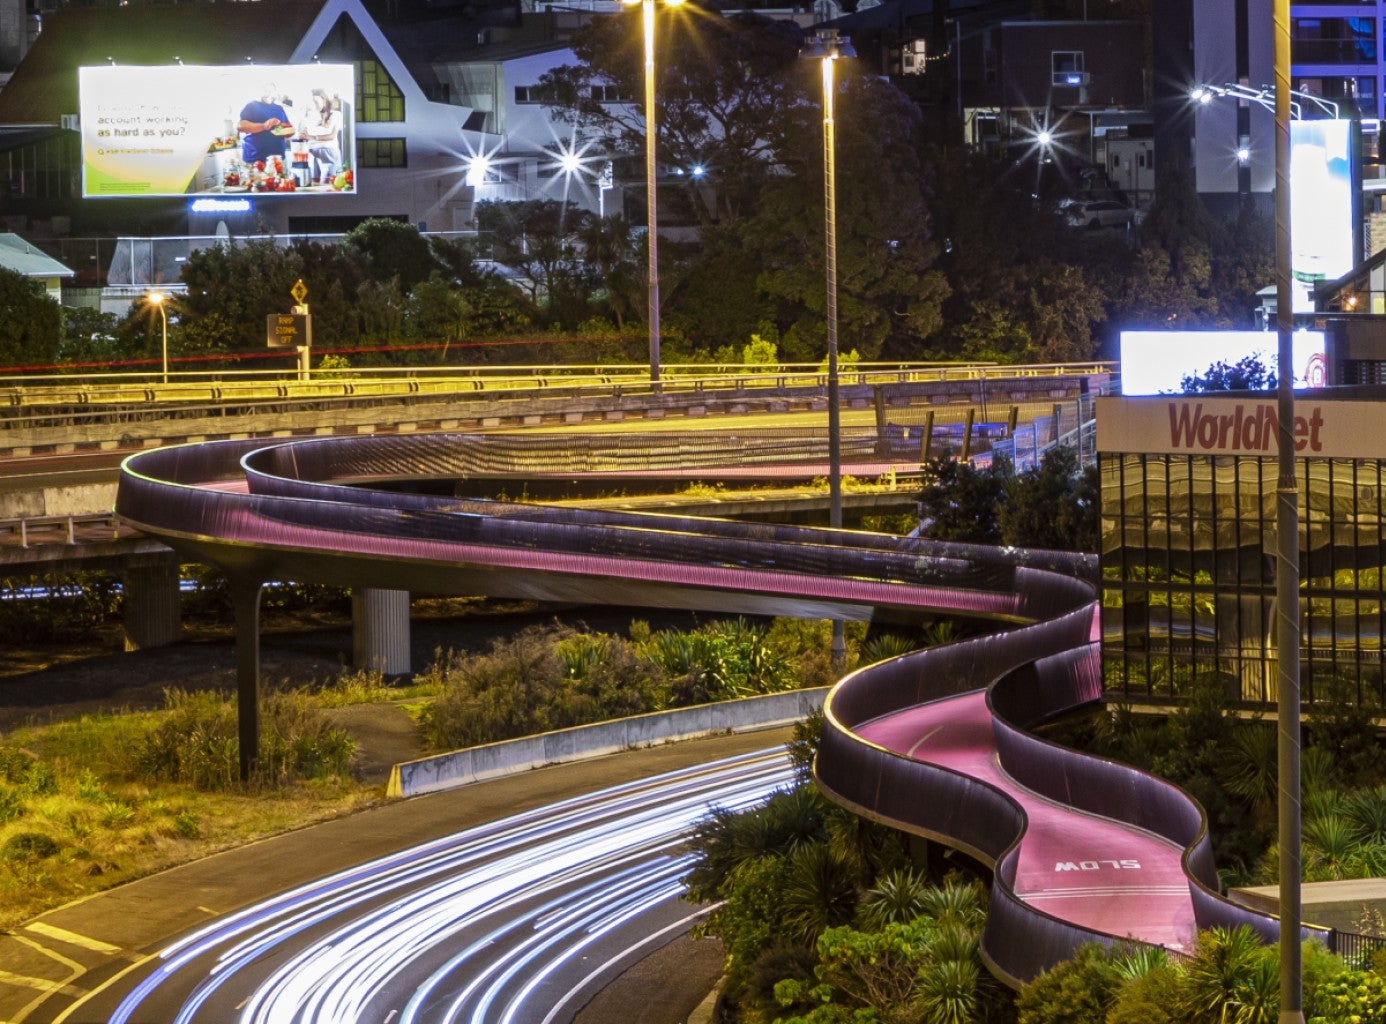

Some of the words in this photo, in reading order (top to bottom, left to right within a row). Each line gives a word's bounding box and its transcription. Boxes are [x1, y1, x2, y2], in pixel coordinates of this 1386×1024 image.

[97, 128, 111, 137] as
[114, 128, 139, 137] hard
[143, 129, 155, 137] as
[159, 126, 186, 138] you?
[1054, 859, 1142, 872] SLOW
